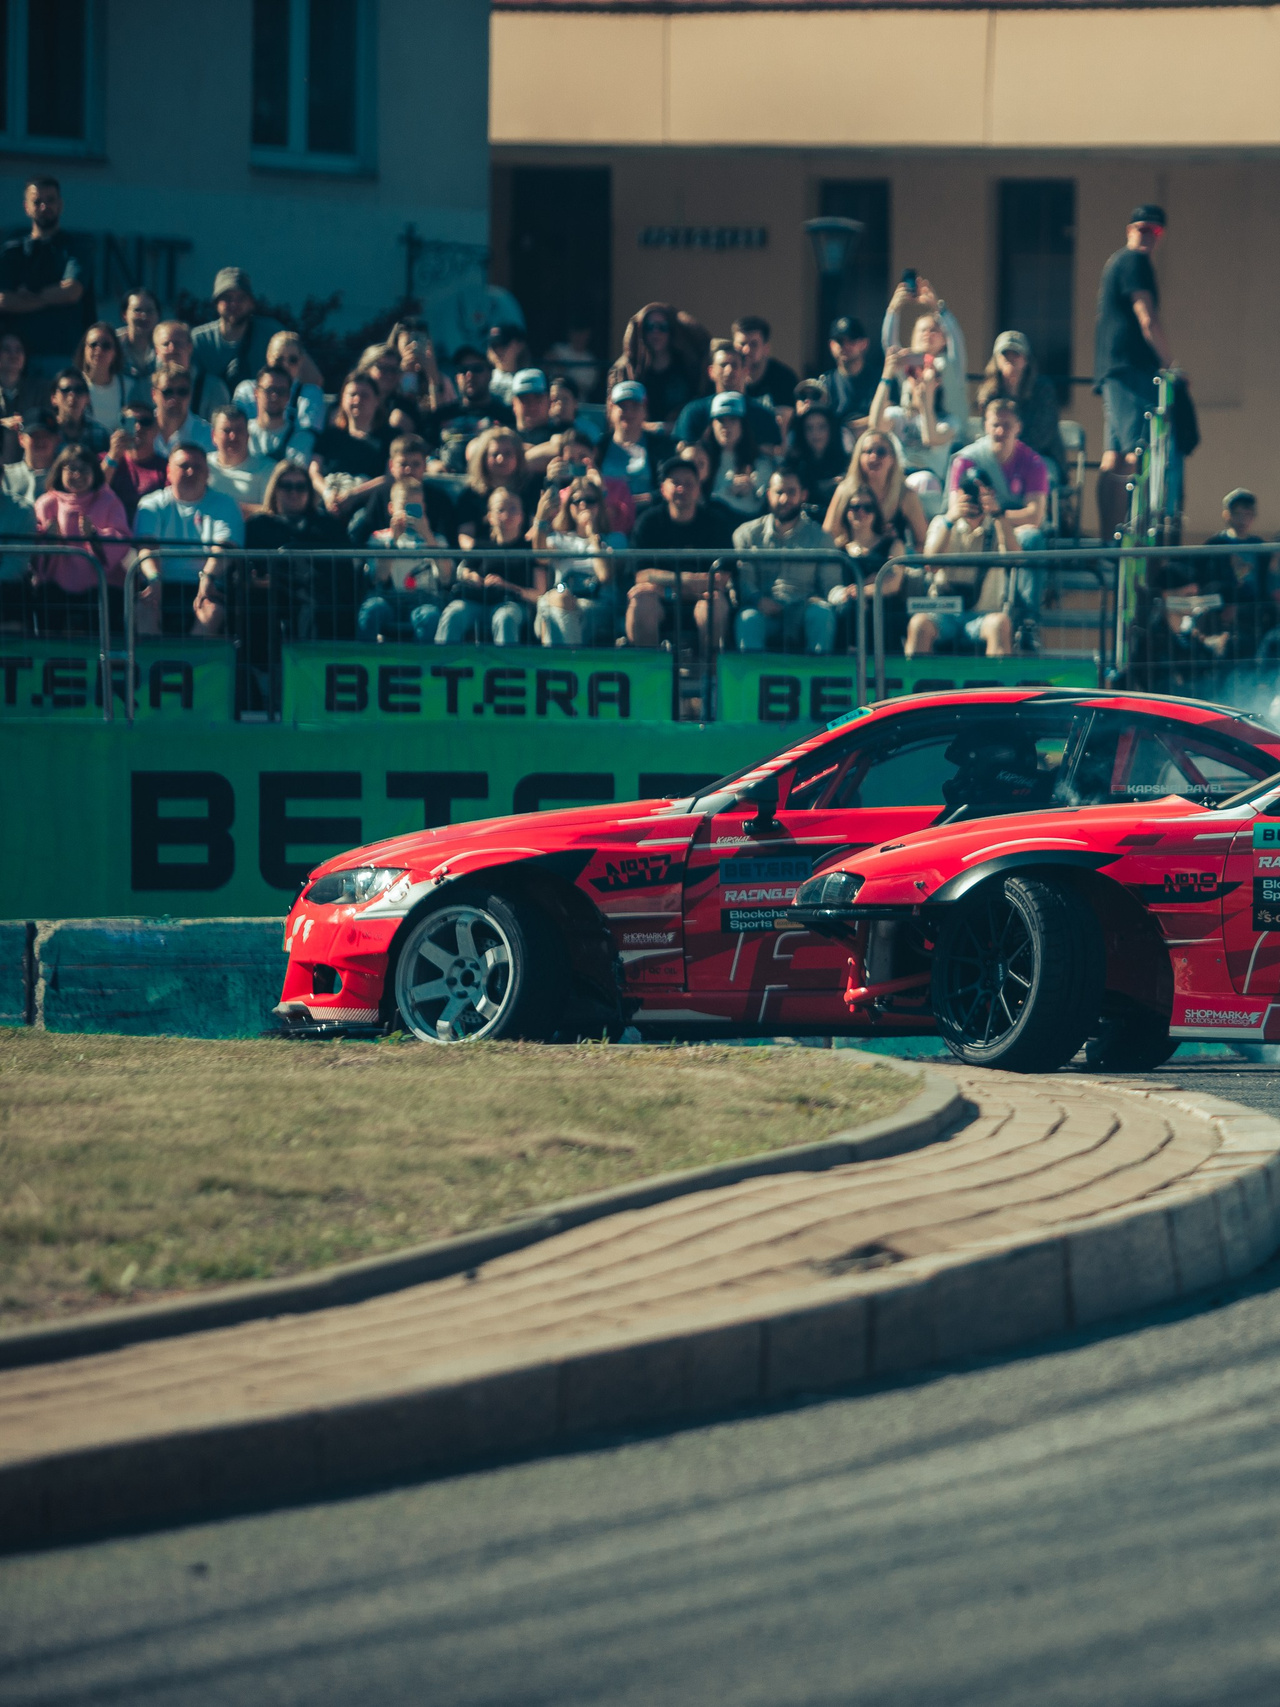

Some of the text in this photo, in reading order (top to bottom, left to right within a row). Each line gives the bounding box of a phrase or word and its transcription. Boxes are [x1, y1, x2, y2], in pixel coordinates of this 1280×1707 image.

[325, 663, 631, 718] BET.ERA
[724, 887, 797, 903] RACING.B
[729, 908, 788, 920] Blockcha
[729, 919, 773, 931] Sports
[1184, 1008, 1250, 1020] SHOPMARKA
